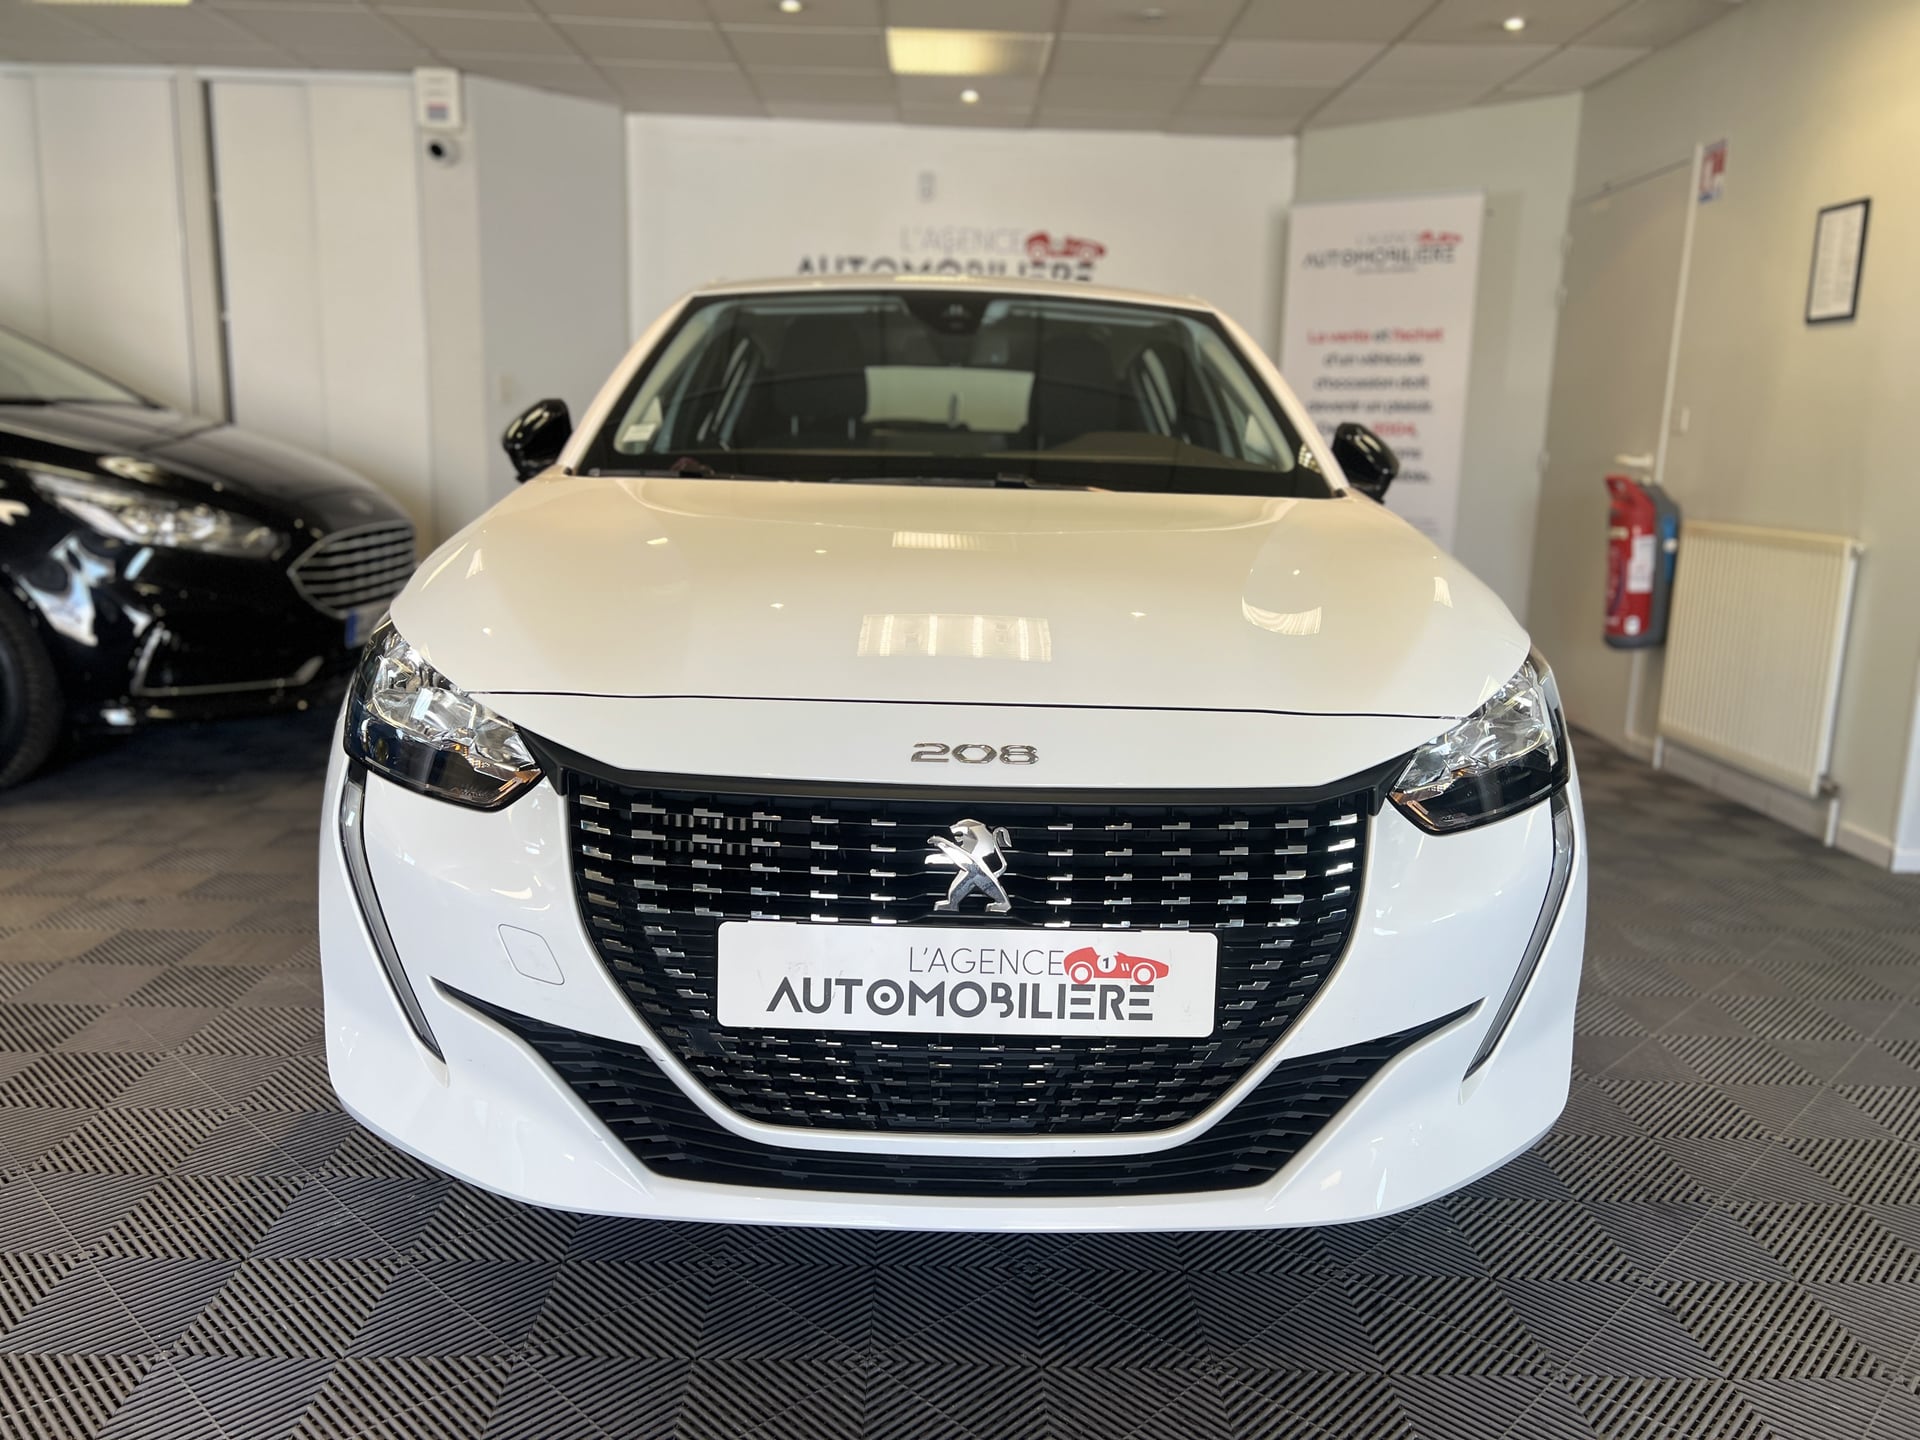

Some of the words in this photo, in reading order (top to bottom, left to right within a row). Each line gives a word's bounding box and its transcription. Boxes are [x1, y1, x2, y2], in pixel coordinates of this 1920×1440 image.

[911, 742, 1039, 765] 208
[909, 945, 1064, 977] L'AGENCE
[1102, 957, 1110, 969] 1
[766, 976, 1154, 1021] AUTOMOBILIERE
